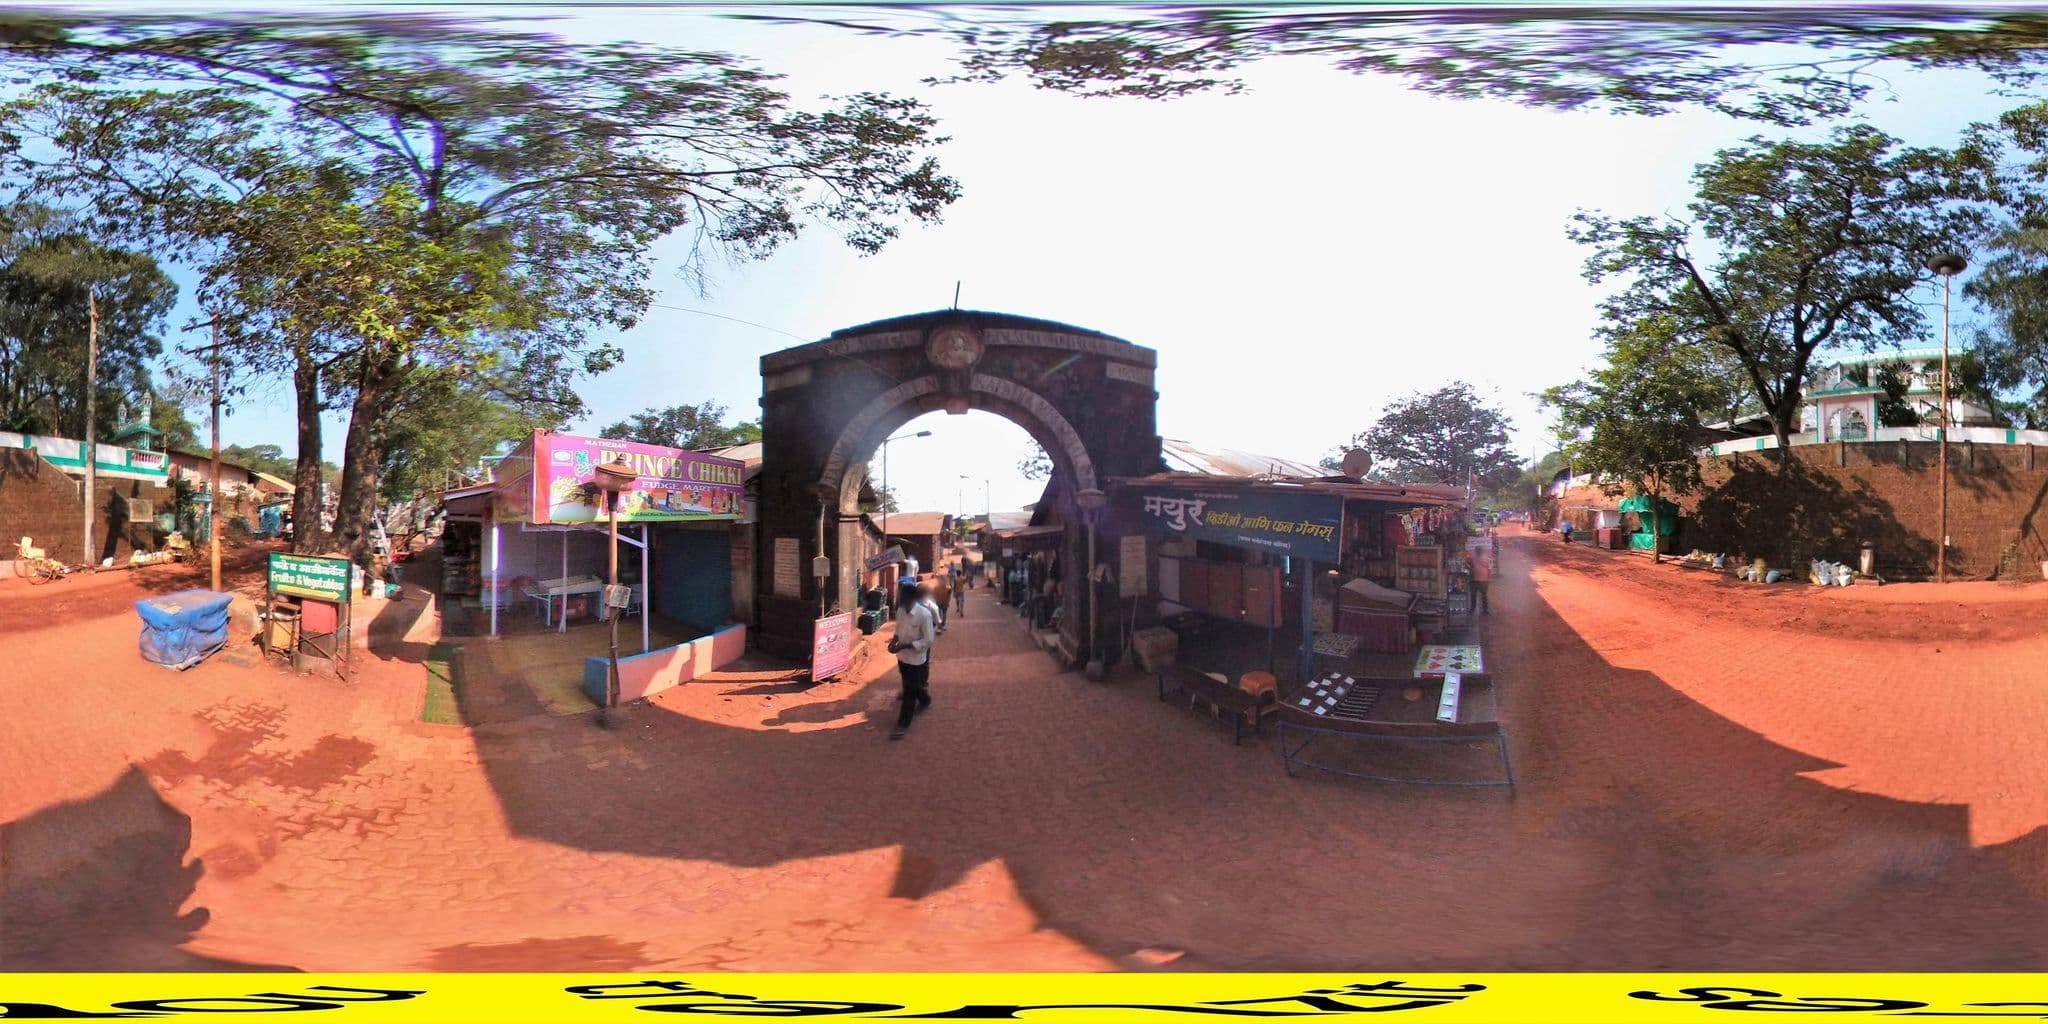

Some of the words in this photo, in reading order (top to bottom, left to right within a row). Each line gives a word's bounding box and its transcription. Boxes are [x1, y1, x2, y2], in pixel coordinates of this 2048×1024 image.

[584, 440, 627, 449] MATHERAN
[600, 450, 682, 479] PRINCE
[688, 460, 742, 485] CHIKKI
[642, 481, 680, 491] FUDGE
[1241, 515, 1272, 531] आणि
[271, 570, 296, 584] Fruits
[303, 575, 345, 591] Vegetables
